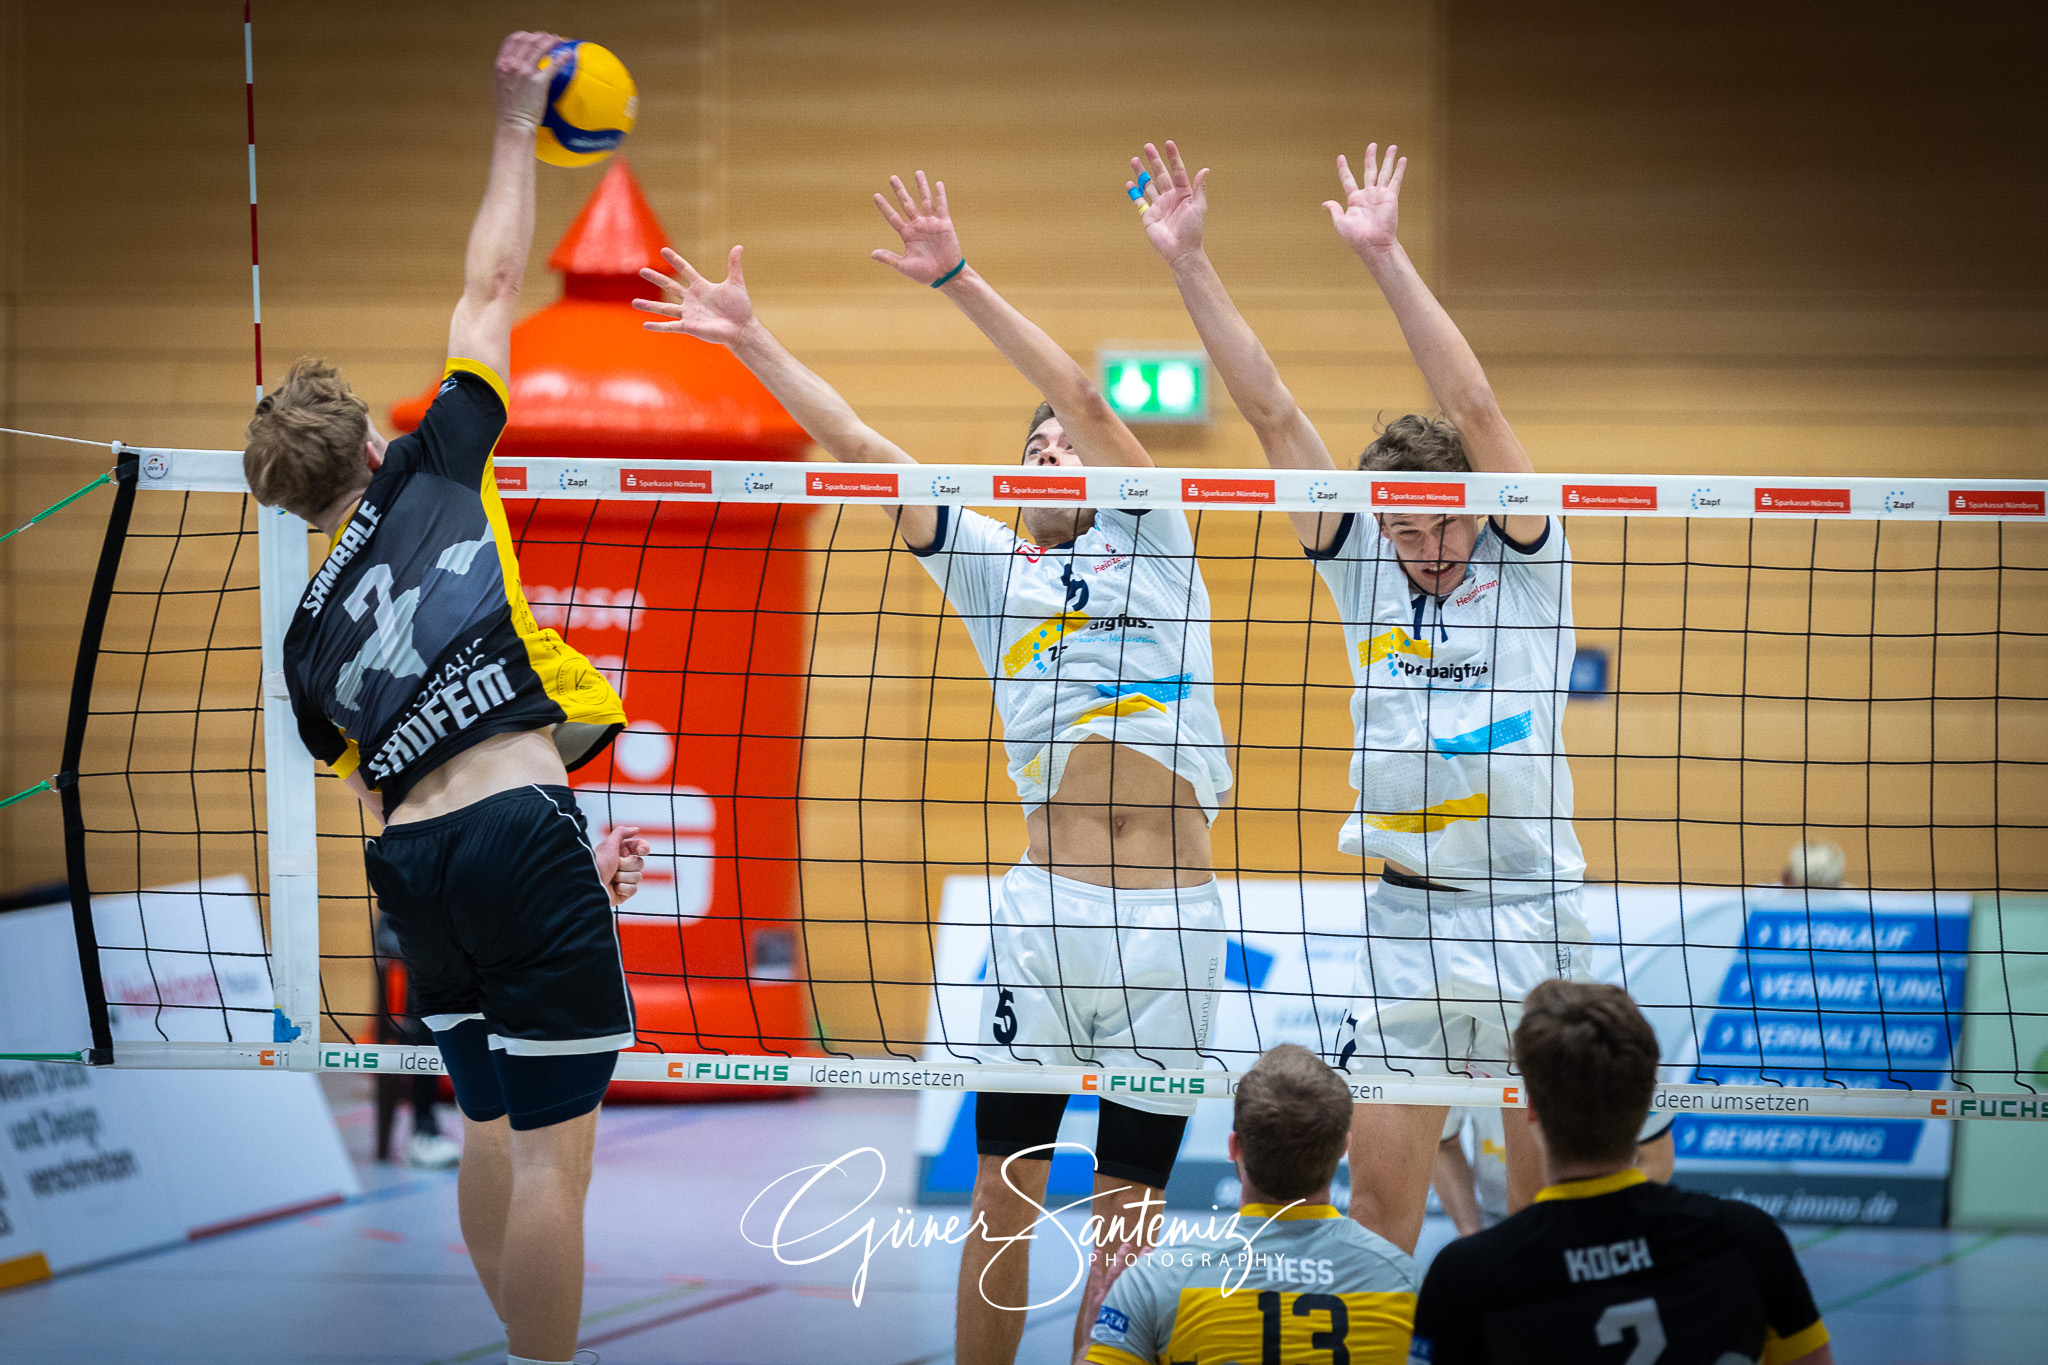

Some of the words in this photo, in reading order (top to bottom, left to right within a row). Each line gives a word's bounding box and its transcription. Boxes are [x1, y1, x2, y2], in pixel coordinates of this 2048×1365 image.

[567, 478, 588, 488] Zapf
[639, 479, 673, 489] Sparkasse
[674, 480, 706, 490] Nürnberg
[753, 481, 774, 490] Zapf
[825, 482, 859, 492] Sparkasse
[860, 483, 892, 493] Nürnberg
[940, 485, 960, 494] Zapf
[1012, 486, 1046, 496] Sparkasse
[1047, 486, 1080, 497] Nürnberg
[1128, 489, 1148, 498] Zapf
[1201, 489, 1235, 499] Sparkasse
[1236, 489, 1269, 500] Nürnberg
[1317, 491, 1338, 501] Zapf
[1390, 492, 1425, 502] Sparkasse
[1426, 493, 1459, 503] Nürnberg
[1507, 495, 1529, 504] Zapf
[1582, 495, 1616, 505] Sparkasse
[1617, 496, 1651, 507] Nürnberg
[1700, 498, 1721, 507] Zapf
[1774, 499, 1809, 509] Sparkasse
[1810, 499, 1844, 509] Nürnberg
[1893, 501, 1915, 510] Zapf
[1968, 501, 2004, 510] Sparkasse
[2005, 502, 2039, 511] Nürnberg
[302, 500, 382, 618] SAMBALE
[1779, 920, 1914, 949] VERKAUF
[1760, 972, 1950, 1001] VERMIETUNG
[992, 987, 1018, 1045] 5
[1740, 1022, 1939, 1055] VERWALTUNG
[695, 1062, 789, 1082] FUCHS
[809, 1065, 862, 1084] Ideen
[869, 1069, 965, 1088] umsetzen
[1110, 1075, 1205, 1094] FUCHS
[1655, 1089, 1704, 1109] deen
[1710, 1093, 1809, 1112] umsetzen
[1960, 1100, 2048, 1119] FUCHS
[1702, 1126, 1887, 1157] BEWERTUNG
[1563, 1236, 1654, 1284] KOCH
[1265, 1255, 1335, 1286] HESS
[1257, 1291, 1350, 1365] 13
